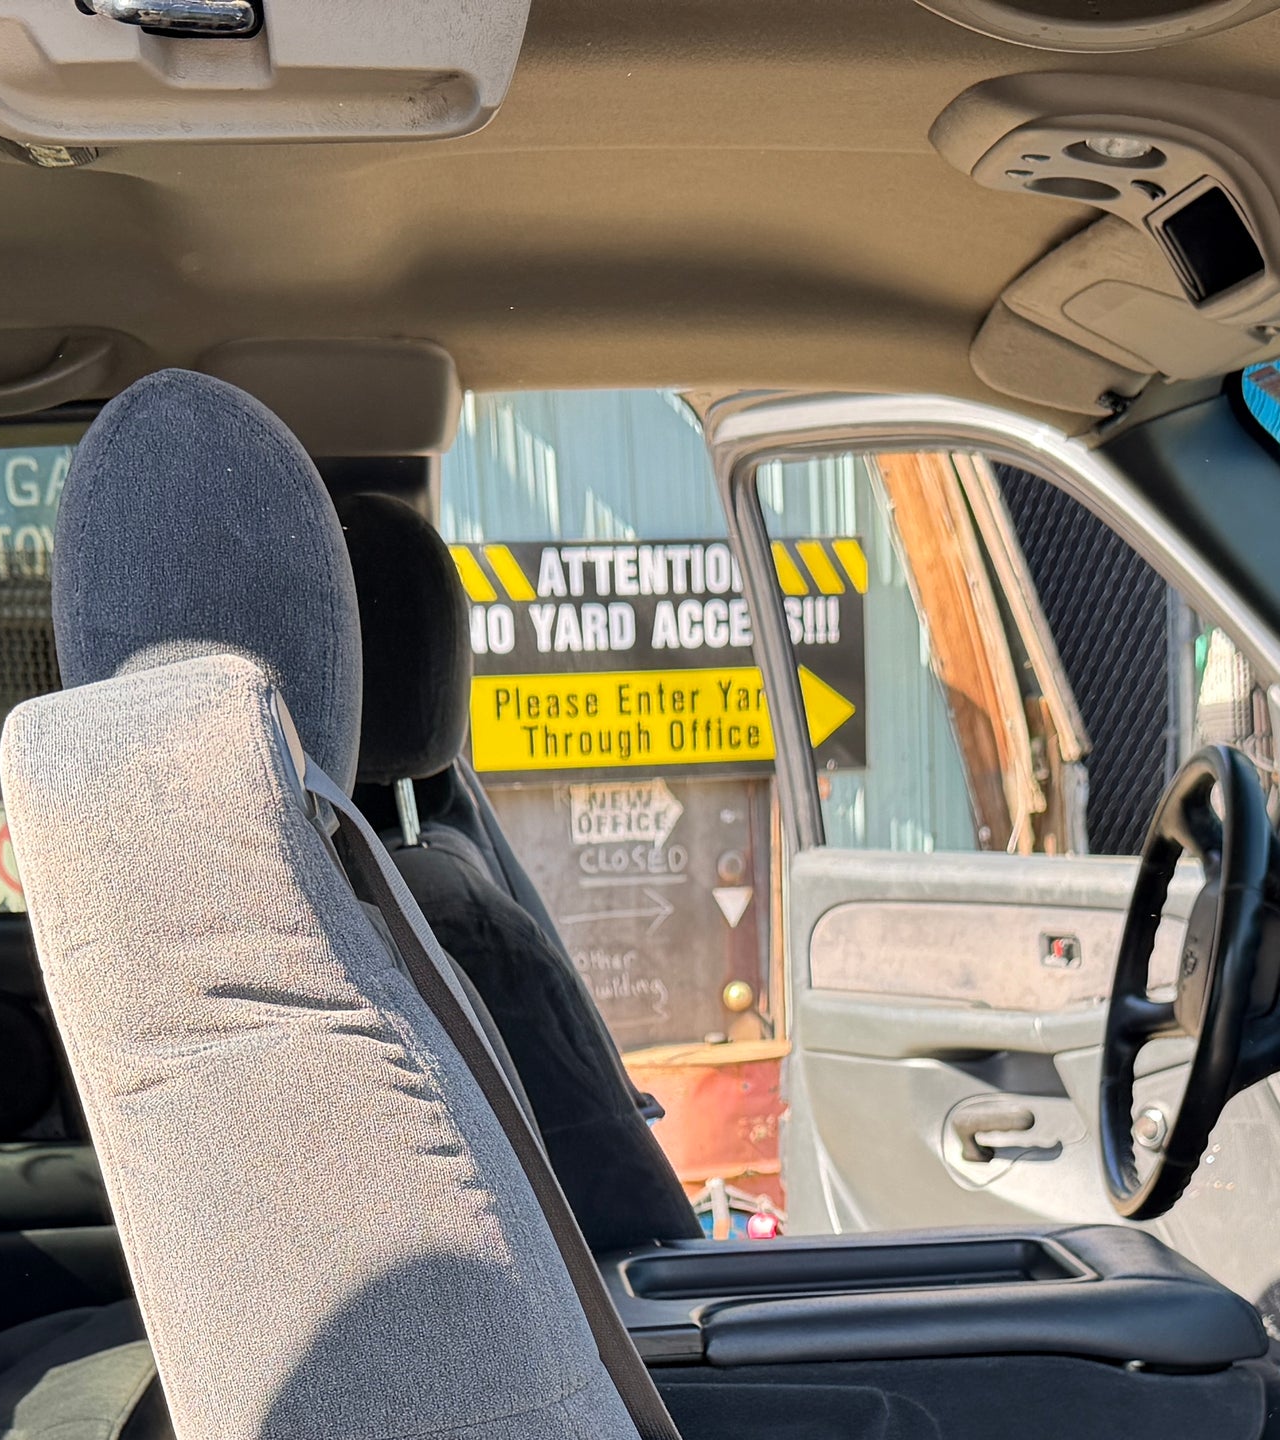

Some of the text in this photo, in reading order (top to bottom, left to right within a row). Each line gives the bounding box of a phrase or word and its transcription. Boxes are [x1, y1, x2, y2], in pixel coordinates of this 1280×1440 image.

[5, 456, 70, 507] GA
[528, 602, 636, 652] YARD
[651, 596, 840, 650] ACCES!!!
[495, 679, 765, 720] Please Enter Yar
[522, 719, 761, 760] Through Office
[588, 788, 653, 810] NEW
[577, 811, 667, 834] OFFICE
[579, 844, 689, 874] CLOSED
